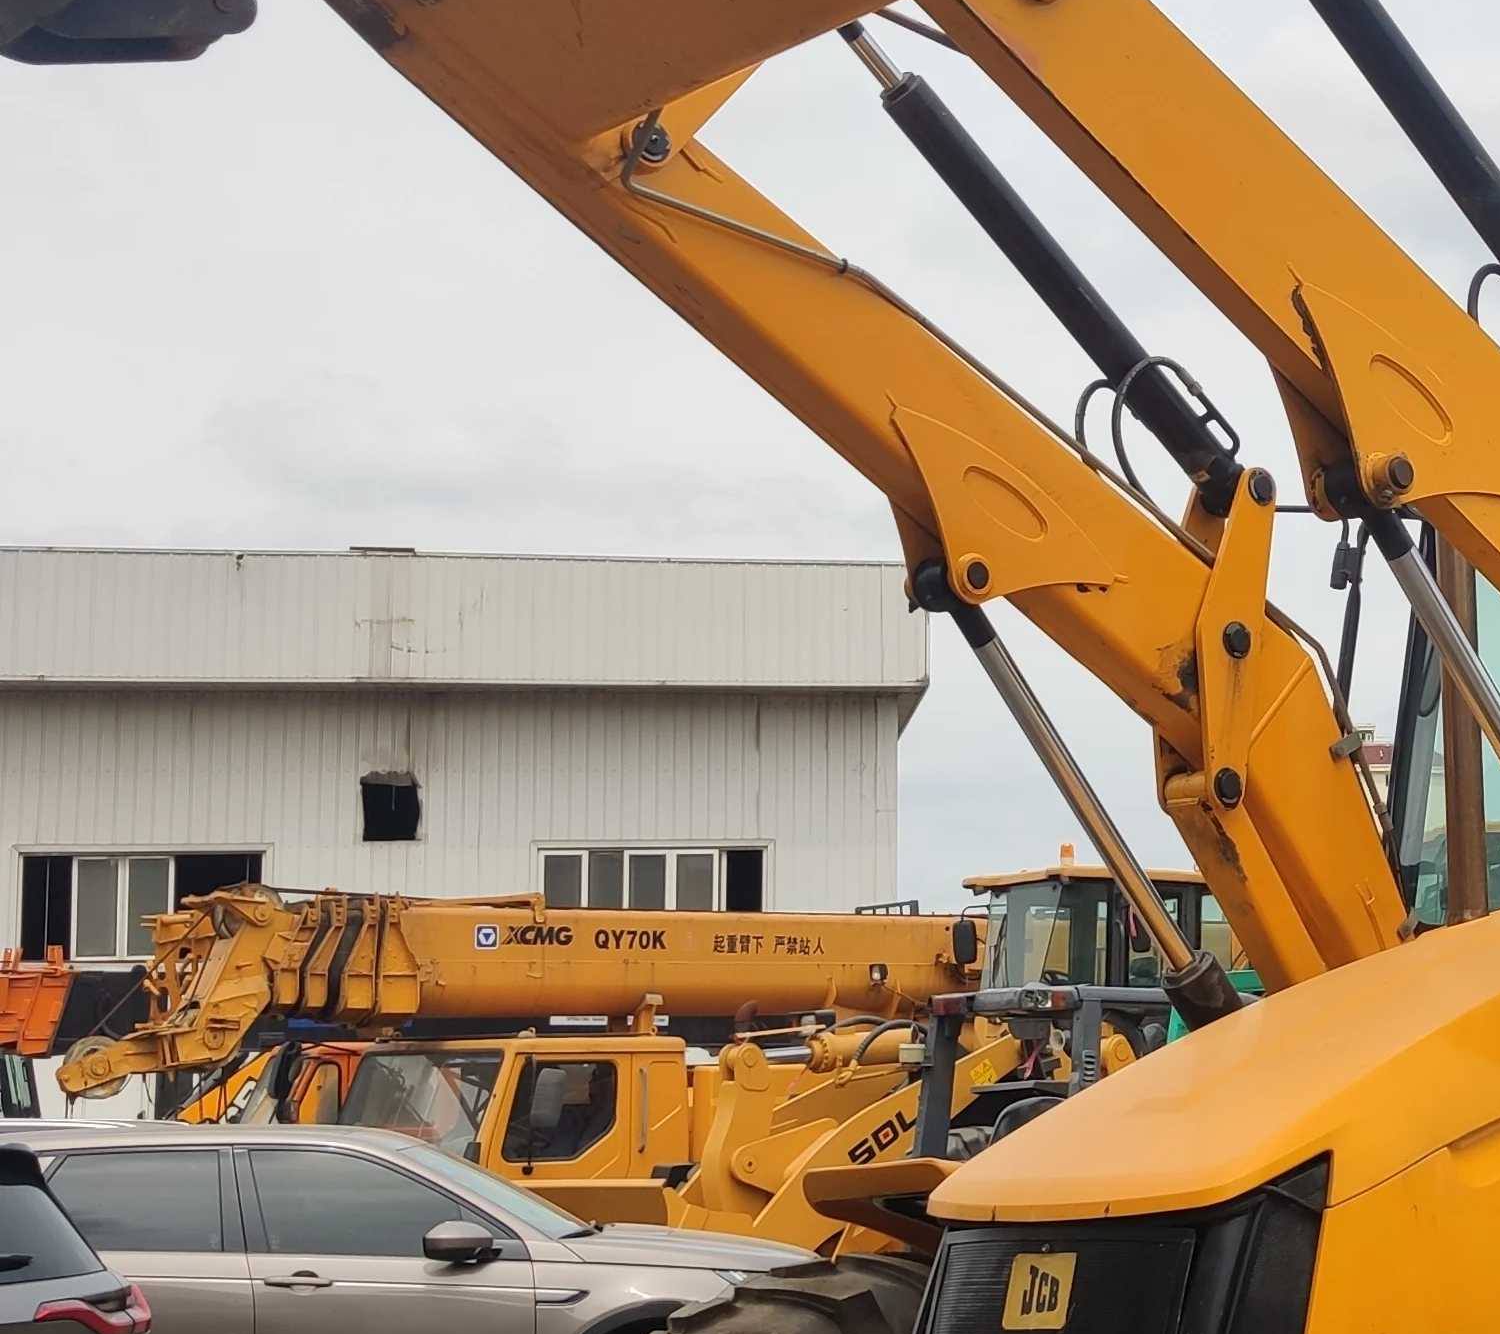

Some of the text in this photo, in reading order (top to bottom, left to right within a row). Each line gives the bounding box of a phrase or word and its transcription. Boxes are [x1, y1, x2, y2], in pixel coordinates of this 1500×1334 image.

[501, 924, 667, 950] XCMG QY70K
[712, 933, 825, 956] 起重臂下 严禁站人
[1020, 1264, 1060, 1317] JCB
